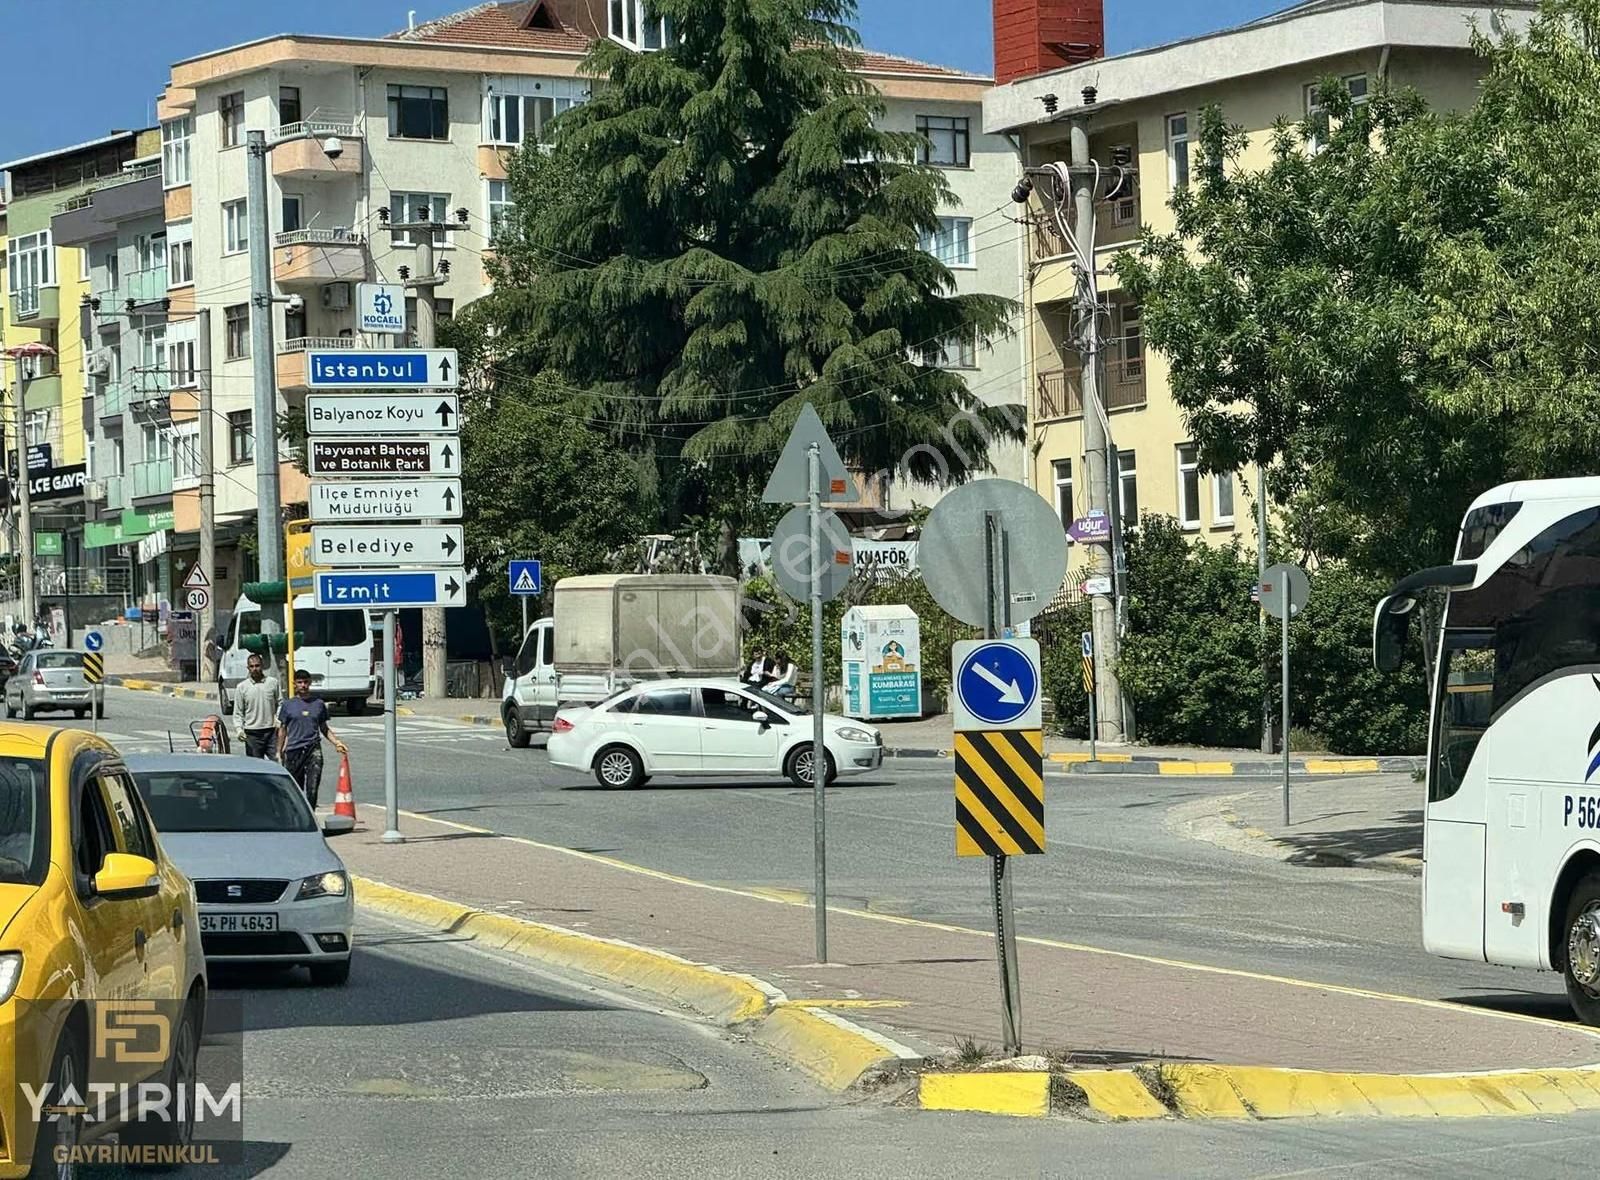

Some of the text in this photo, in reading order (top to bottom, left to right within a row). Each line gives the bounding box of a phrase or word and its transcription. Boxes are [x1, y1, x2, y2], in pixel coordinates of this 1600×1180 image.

[316, 358, 412, 377] İstanbul
[313, 406, 424, 423] Balyanoz Koyu
[314, 444, 429, 457] Hayvanat Bahçesi
[321, 459, 424, 470] ve Botanik Park
[320, 486, 419, 501] İlçe Emniyet
[329, 503, 412, 516] Müdürlüğü
[1078, 518, 1103, 533] uğur
[321, 538, 414, 556] Belediye
[328, 579, 390, 599] İzmit
[190, 593, 204, 606] 30
[1564, 795, 1573, 827] P
[200, 917, 273, 930] 34 PH 4643
